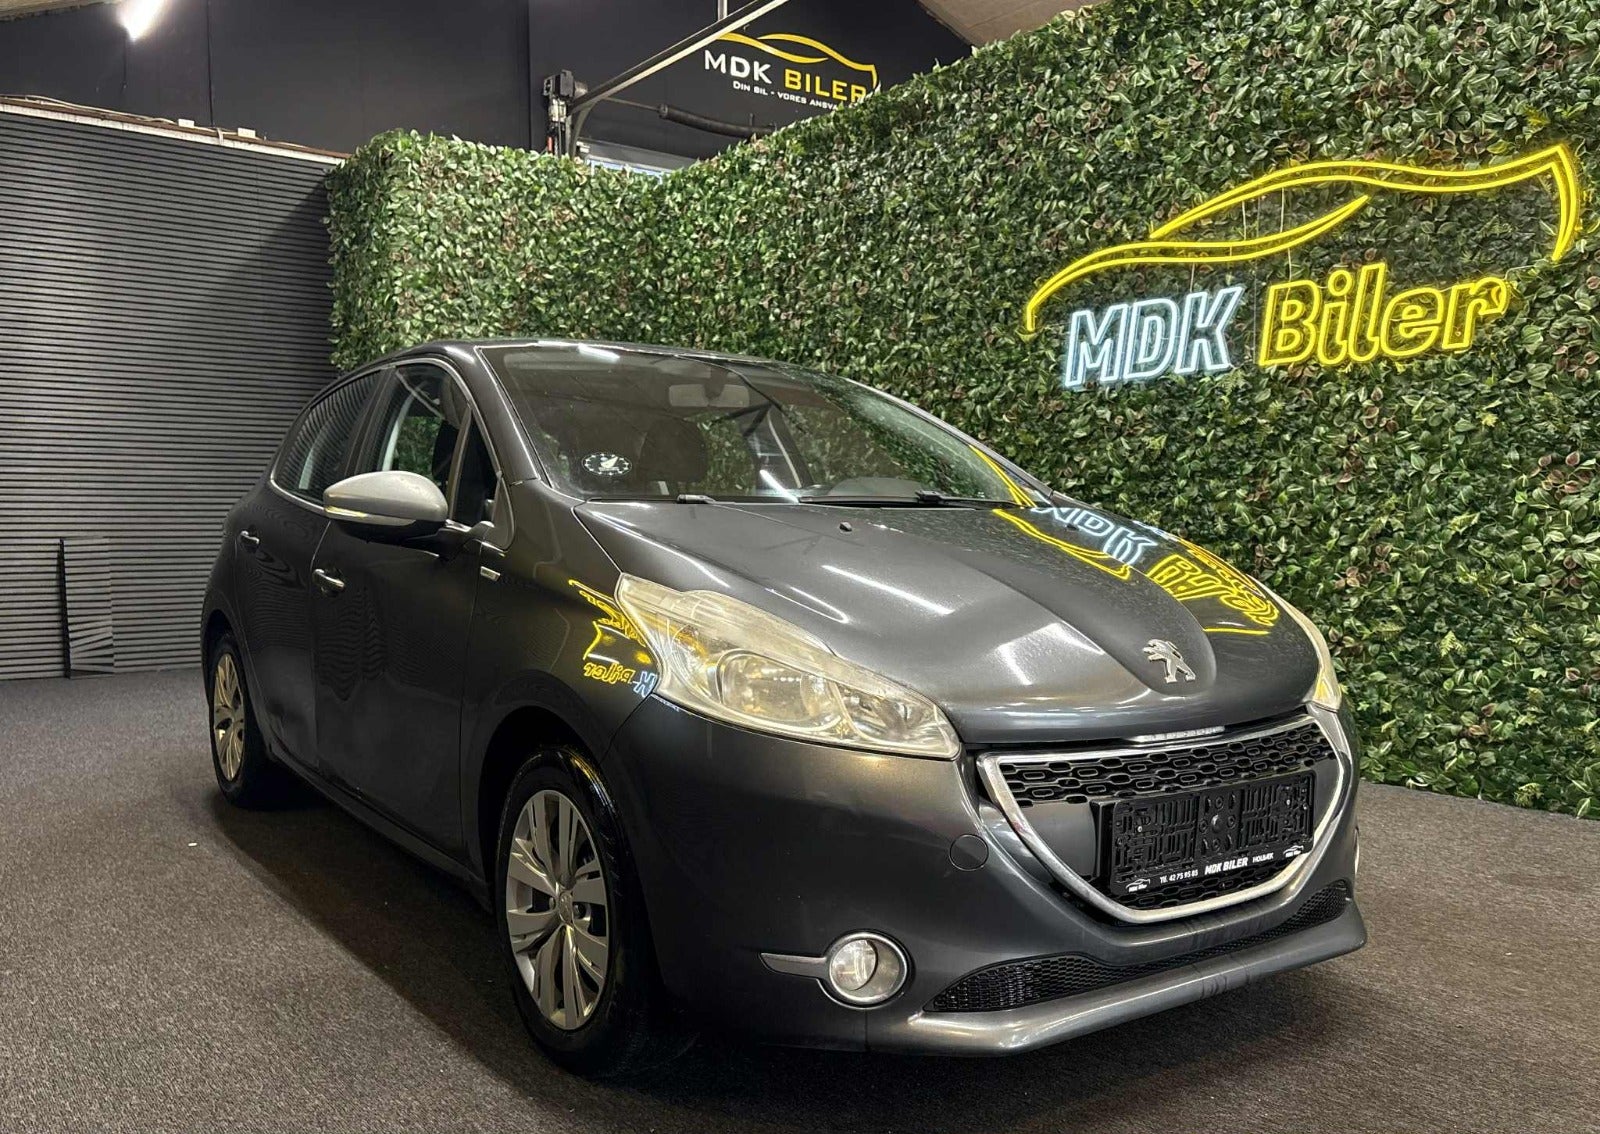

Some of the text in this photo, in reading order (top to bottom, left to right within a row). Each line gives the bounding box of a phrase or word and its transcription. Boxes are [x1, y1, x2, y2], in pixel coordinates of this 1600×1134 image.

[704, 49, 867, 104] MDK BILER
[732, 80, 751, 92] DIN
[753, 86, 768, 96] BIL
[777, 91, 807, 105] VORES
[809, 98, 840, 111] ANSVA
[1063, 262, 1509, 389] MDK Biler
[1169, 873, 1176, 882] 42
[1176, 872, 1184, 880] 75
[1204, 862, 1223, 875] MDK
[1222, 857, 1248, 871] BILER
